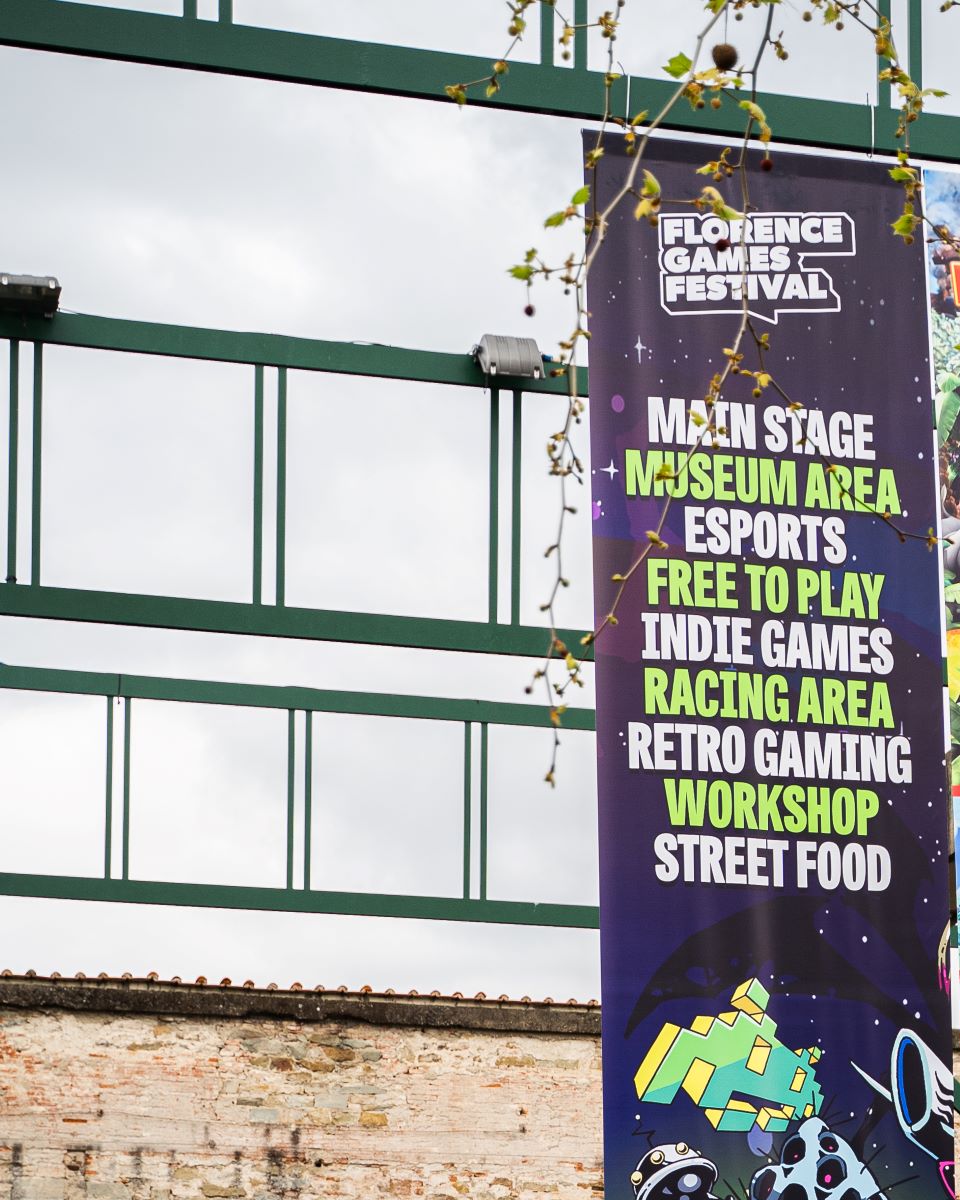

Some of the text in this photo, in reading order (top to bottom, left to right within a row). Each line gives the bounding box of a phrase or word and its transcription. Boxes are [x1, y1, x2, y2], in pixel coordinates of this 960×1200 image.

[663, 217, 843, 244] FLORENCE
[663, 246, 791, 273] GAMES
[665, 273, 828, 302] FESTIVAL
[647, 396, 876, 461] MAIN STAGE
[625, 449, 902, 515] MUSEUM AREA
[684, 506, 848, 564] ESPORTS
[647, 558, 885, 620] FREE TO PLAY
[641, 613, 894, 675] INDIE GAMES
[644, 667, 895, 729] RACING AREA
[627, 721, 912, 784] RETRO GAMING
[663, 778, 880, 836] WORKSHOP
[653, 833, 892, 892] STREET FOOD
